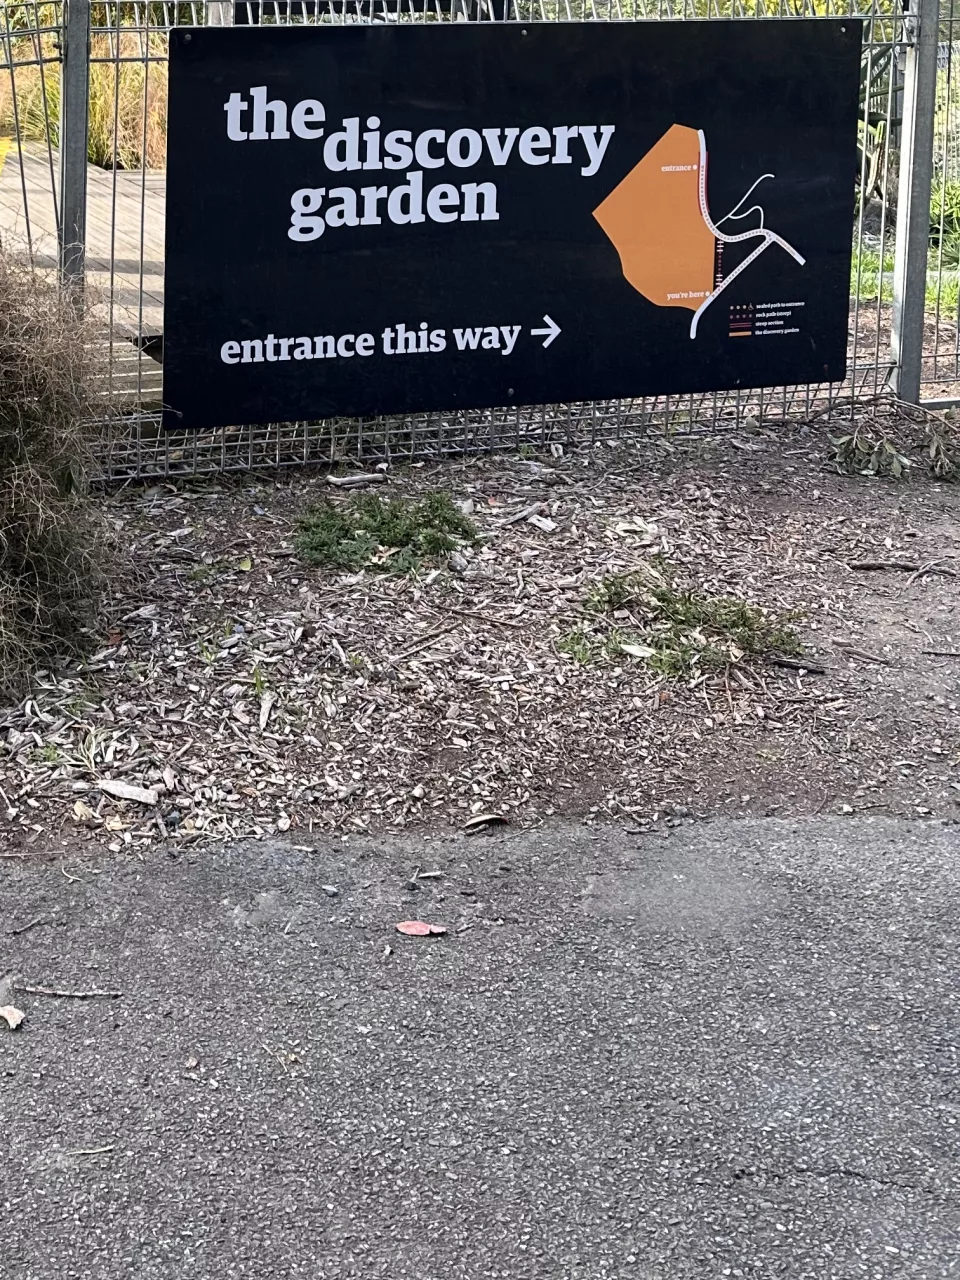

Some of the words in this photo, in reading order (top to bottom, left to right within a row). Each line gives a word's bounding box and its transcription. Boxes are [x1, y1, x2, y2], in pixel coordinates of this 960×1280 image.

[224, 86, 325, 141] the
[324, 116, 615, 176] discovery
[661, 164, 692, 172] entrance
[288, 171, 499, 241] garden
[221, 333, 375, 364] entrance
[382, 322, 446, 354] this
[453, 326, 521, 355] way
